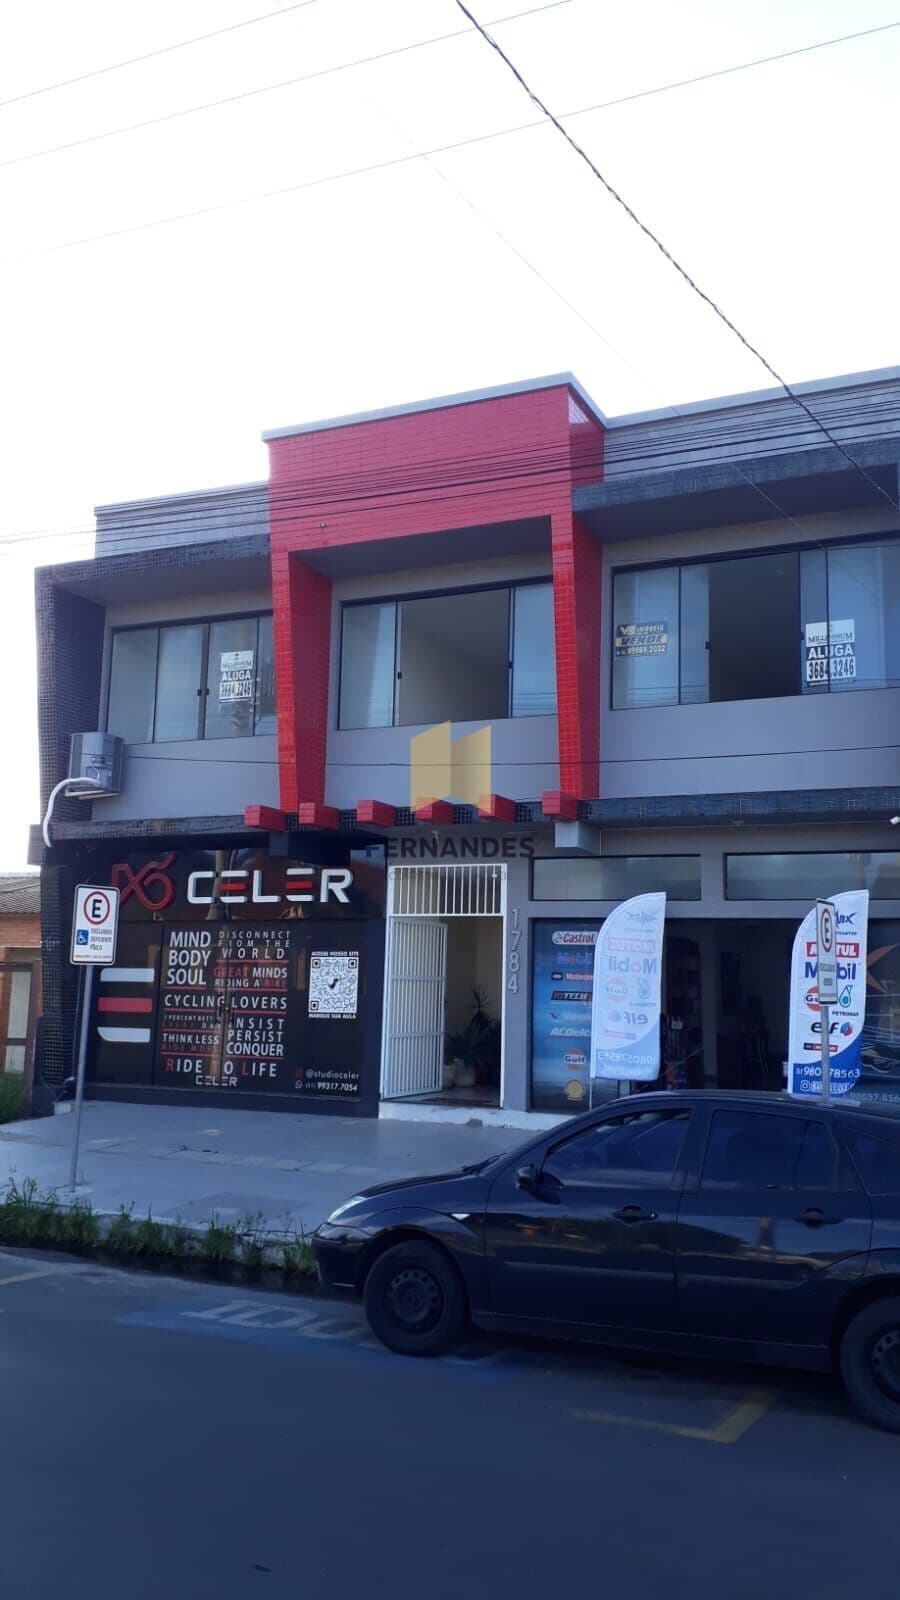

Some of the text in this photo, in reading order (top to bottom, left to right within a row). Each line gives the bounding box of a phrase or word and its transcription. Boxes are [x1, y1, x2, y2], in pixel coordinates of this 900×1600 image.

[621, 634, 664, 647] VENDE
[808, 644, 854, 660] ALUGA
[221, 670, 252, 681] ALUGA
[187, 867, 355, 905] CELER
[92, 899, 102, 918] E
[169, 931, 212, 948] MIND
[218, 930, 291, 939] DISCONNECT
[563, 932, 595, 944] Castrol
[265, 940, 290, 948] THE
[809, 943, 857, 956] MTUL
[222, 947, 285, 960] WORLD
[507, 908, 523, 994] 1784
[168, 949, 212, 967] BODY
[166, 967, 207, 985] SOUL
[252, 967, 288, 979] MINDS
[804, 961, 857, 980] Mbil
[214, 978, 249, 989] RIDING
[164, 993, 288, 1010] CYCLING LOVERS
[810, 1021, 840, 1035] ef
[227, 1030, 284, 1043] PERSIST
[226, 1041, 284, 1057] CONQUER
[166, 1057, 203, 1074] RIDE
[242, 1060, 278, 1078] LIFE
[803, 1066, 861, 1079] 98078563
[195, 1074, 239, 1087] CELER
